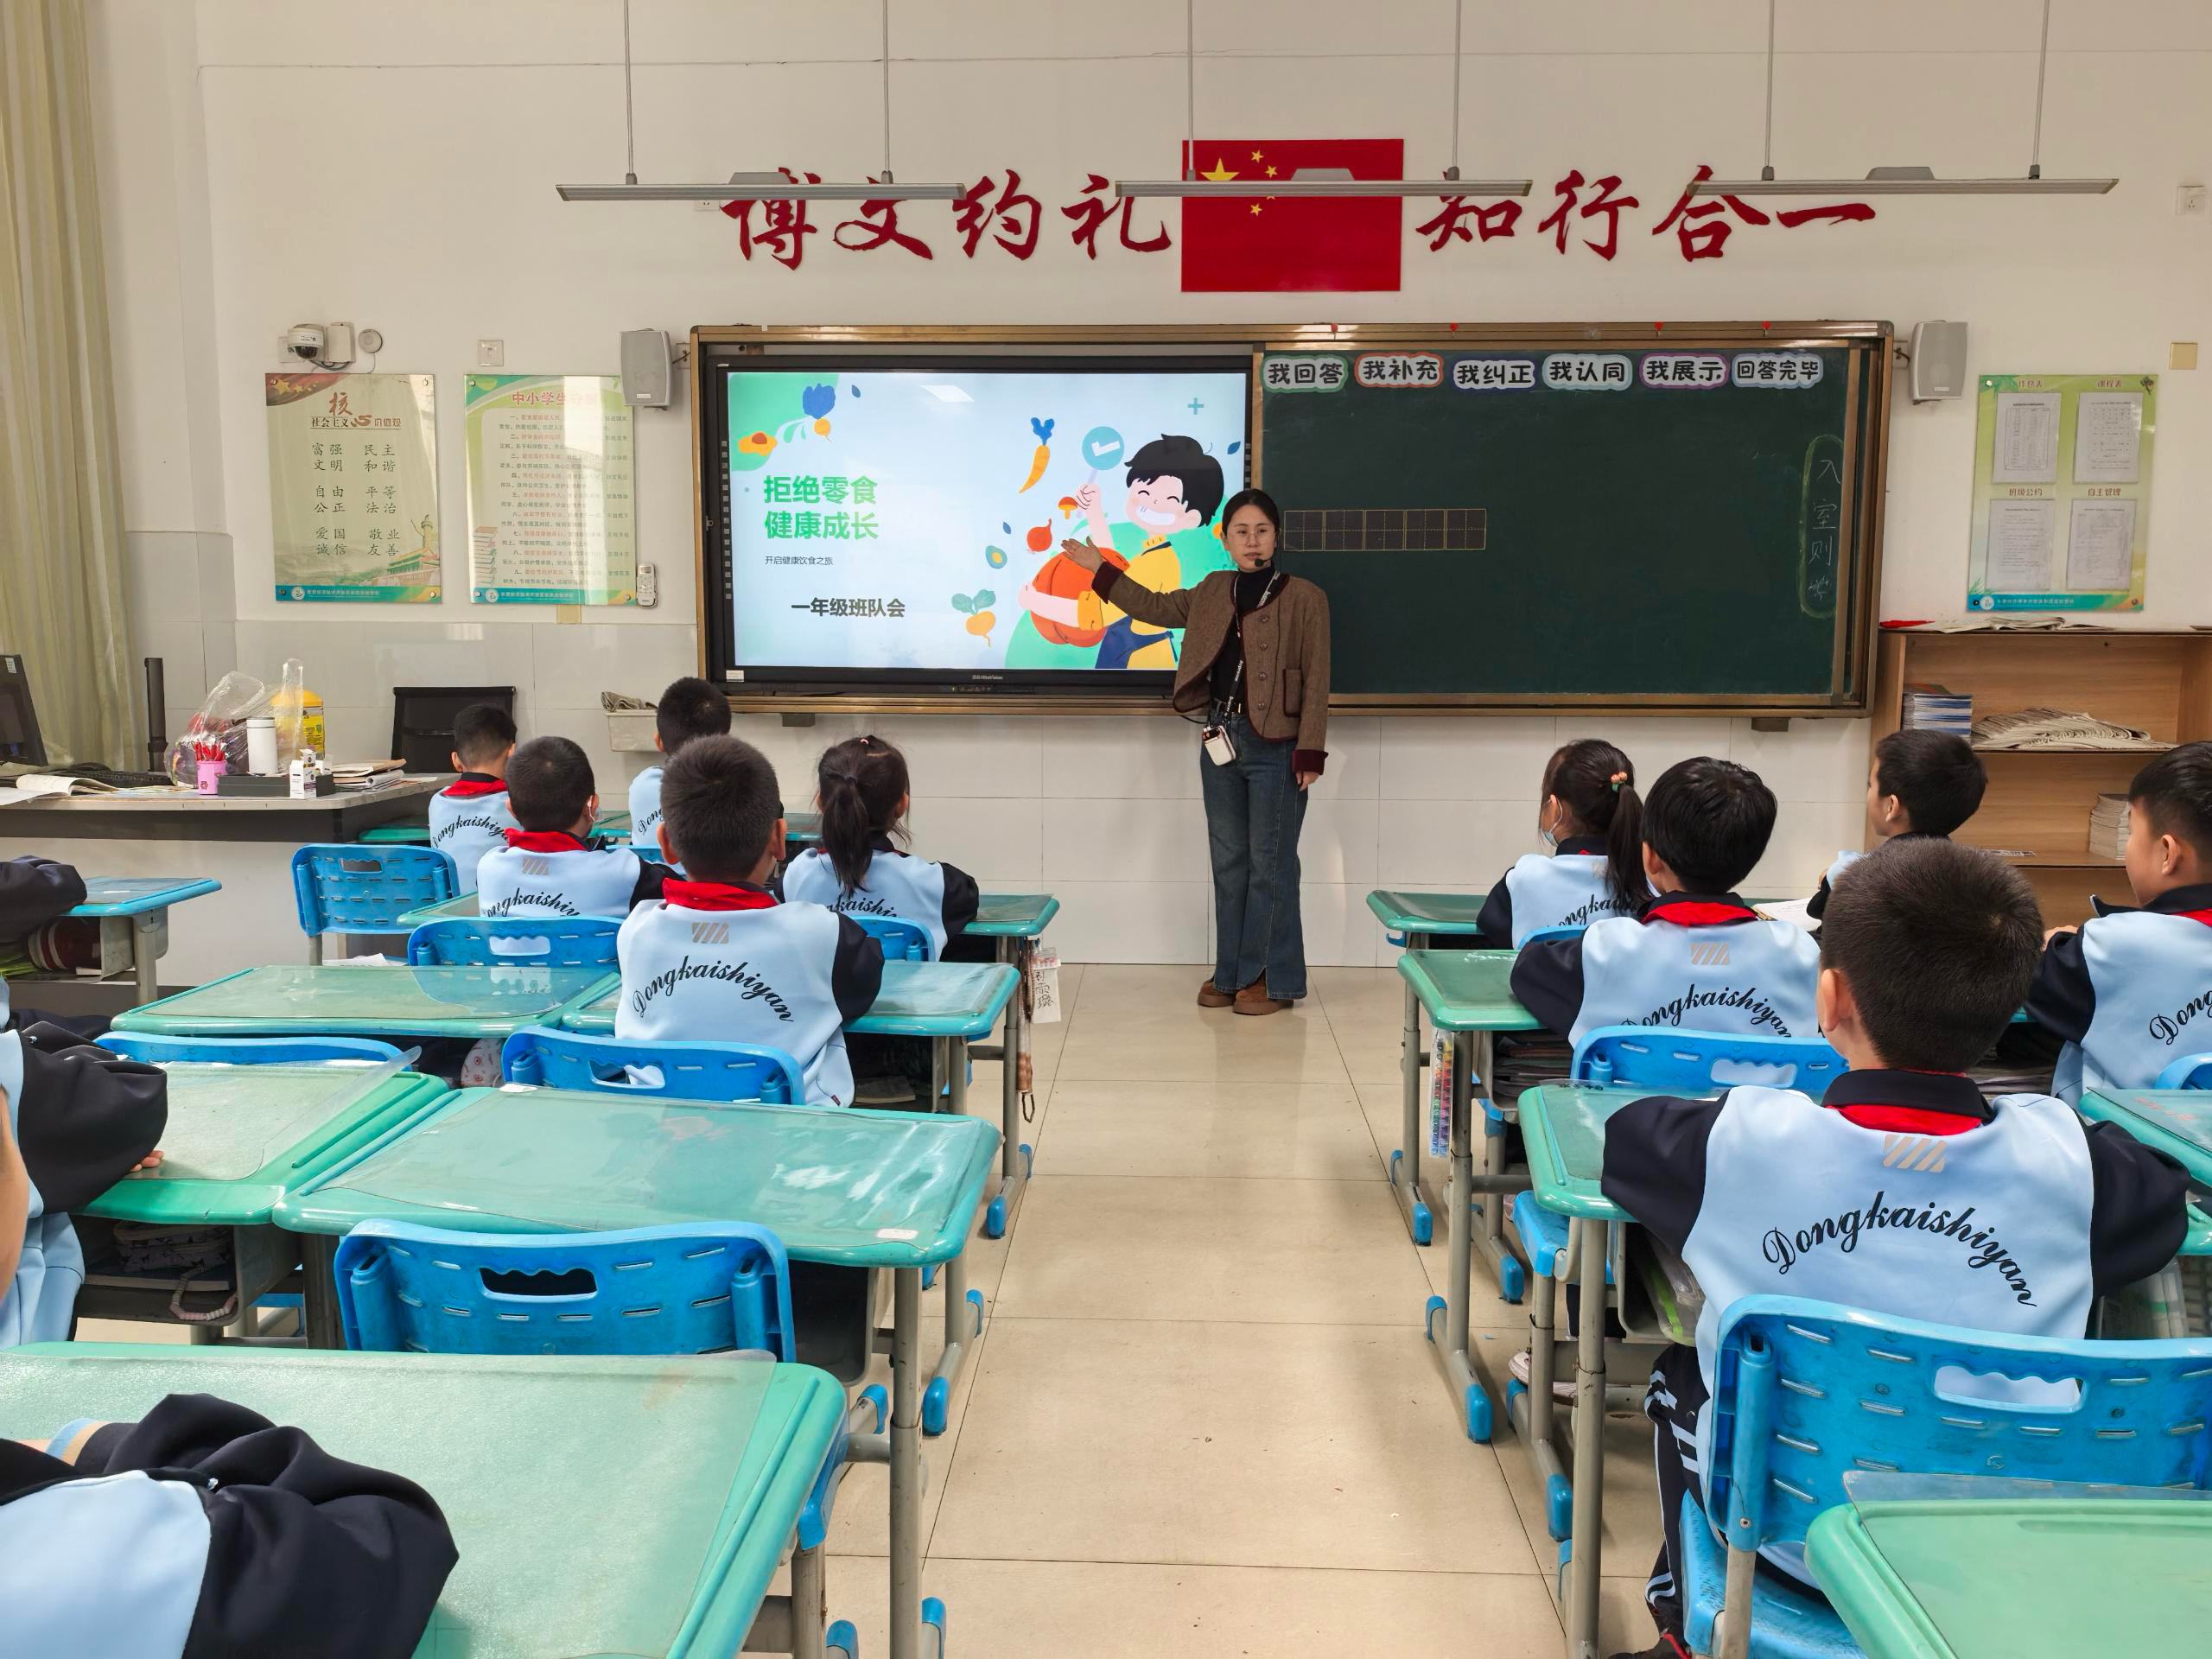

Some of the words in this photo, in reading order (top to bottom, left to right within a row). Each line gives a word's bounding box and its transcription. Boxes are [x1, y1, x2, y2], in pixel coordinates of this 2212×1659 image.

[721, 167, 1172, 270] 博文约礼
[1415, 165, 1877, 262] 知行合一
[1268, 363, 1343, 385] 我回答
[1363, 359, 1439, 381] 我补充
[1457, 364, 1532, 385] 我纠正
[1549, 360, 1624, 382] 我认同
[1646, 359, 1723, 382] 我展示
[1737, 360, 1819, 381] 回答完毕
[512, 391, 597, 406] 中小学生
[312, 442, 342, 456] 富强
[365, 444, 396, 456] 民主
[314, 459, 343, 472] 文明
[364, 460, 396, 473] 和谐
[315, 485, 344, 499] 自由
[365, 486, 397, 499] 平等
[763, 474, 878, 505] 拒绝零食
[2008, 487, 2043, 497] 班级公约
[2088, 487, 2121, 497] 自主管理
[314, 502, 346, 513] 公正
[366, 501, 397, 514] 法治
[764, 510, 879, 540] 健康成长
[315, 526, 346, 540] 爱国
[369, 528, 400, 540] 敬业
[316, 543, 346, 556] 诚信
[367, 543, 399, 556] 友善
[765, 556, 834, 566] 开启健康饮食之旅
[791, 597, 906, 618] 一年级班队会
[632, 956, 794, 1022] Dongkaishiyan
[1621, 983, 1791, 1037] ongkaishiyan
[1763, 1191, 2037, 1306] Dongkaishiyan
